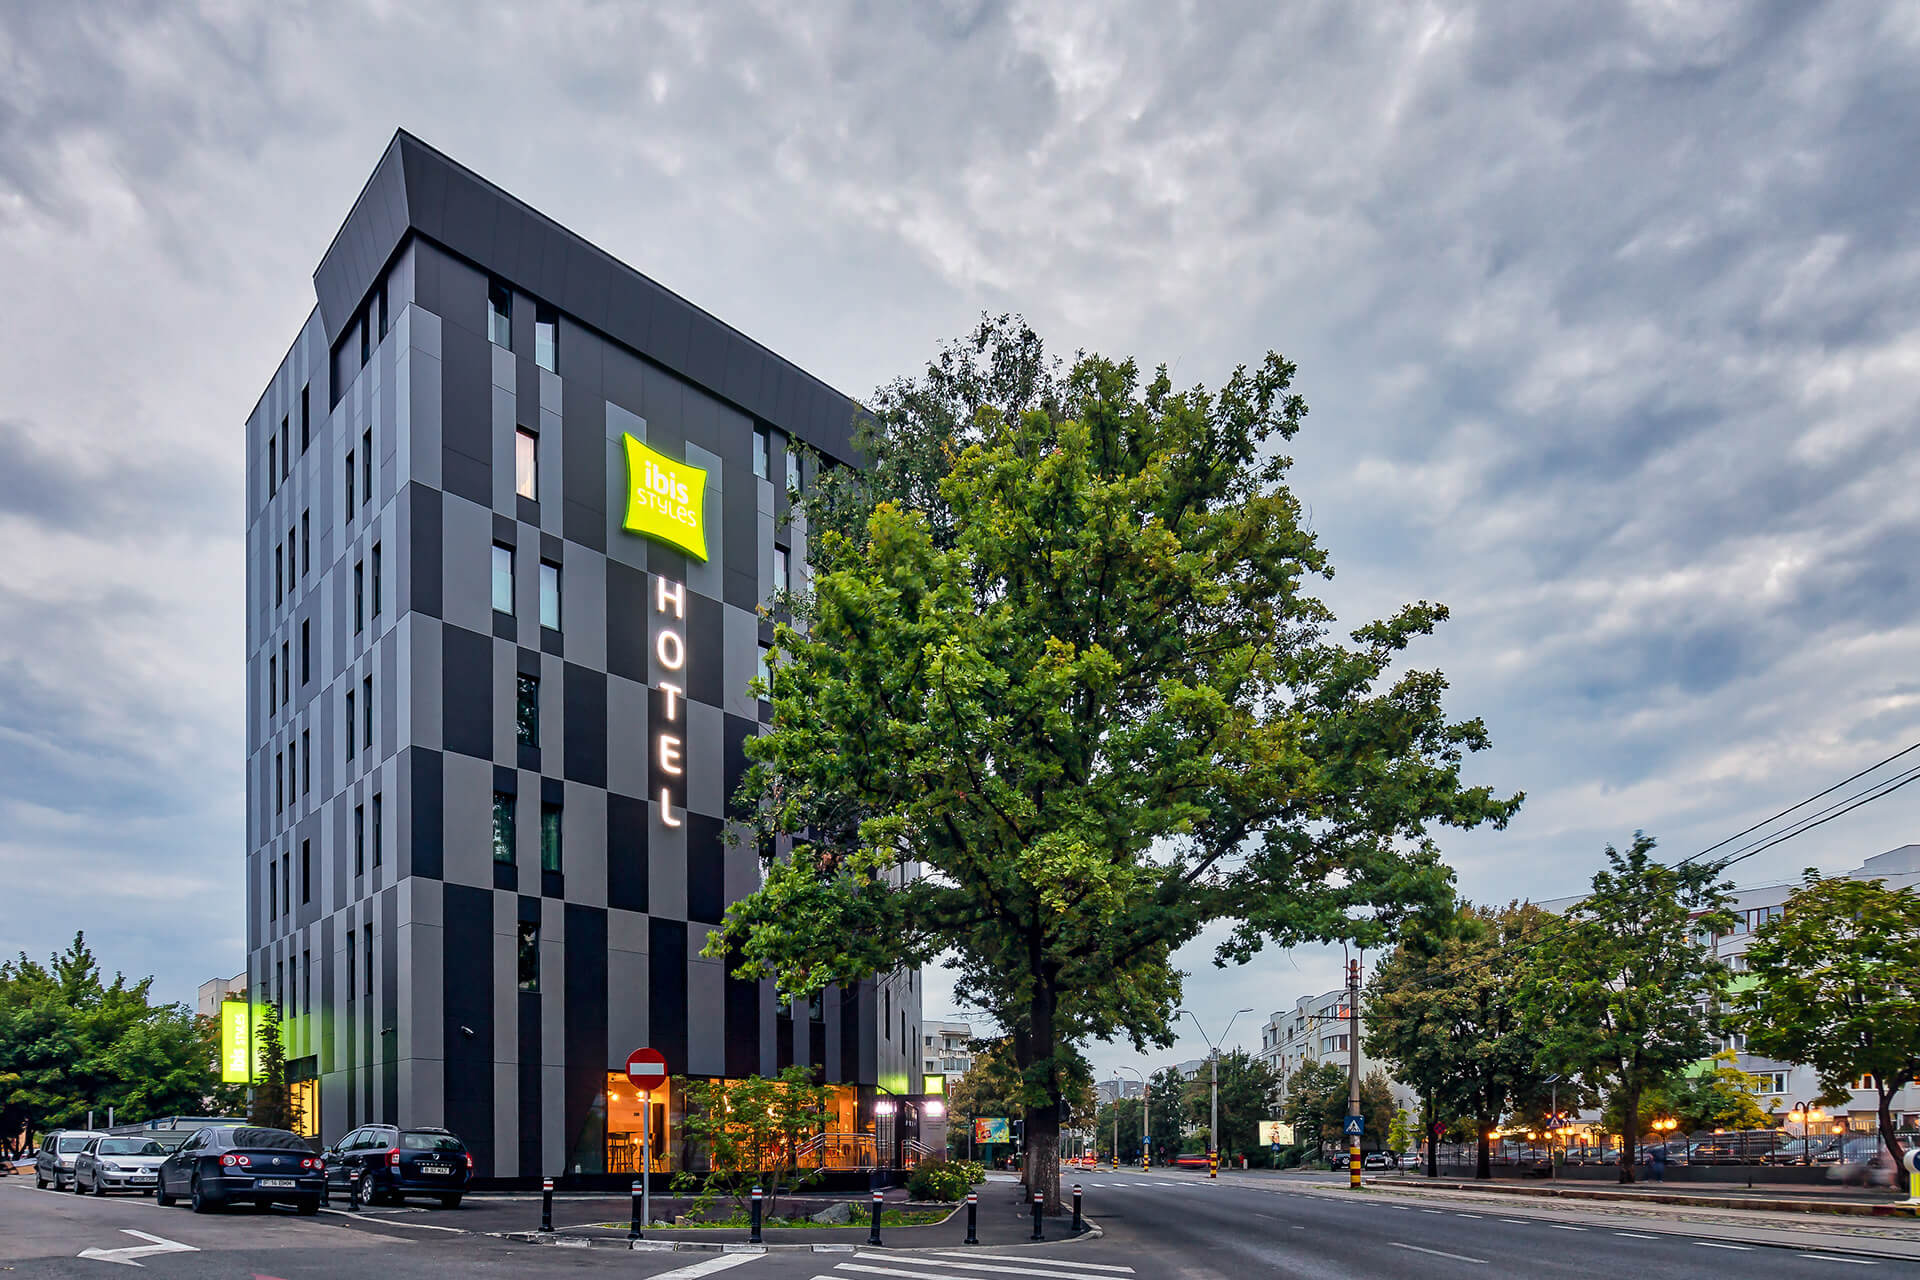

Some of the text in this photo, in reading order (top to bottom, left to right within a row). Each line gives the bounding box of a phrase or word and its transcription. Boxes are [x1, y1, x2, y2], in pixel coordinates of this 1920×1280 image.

[645, 460, 688, 505] ibis
[657, 576, 684, 827] HOTEL
[229, 1048, 246, 1072] ibis
